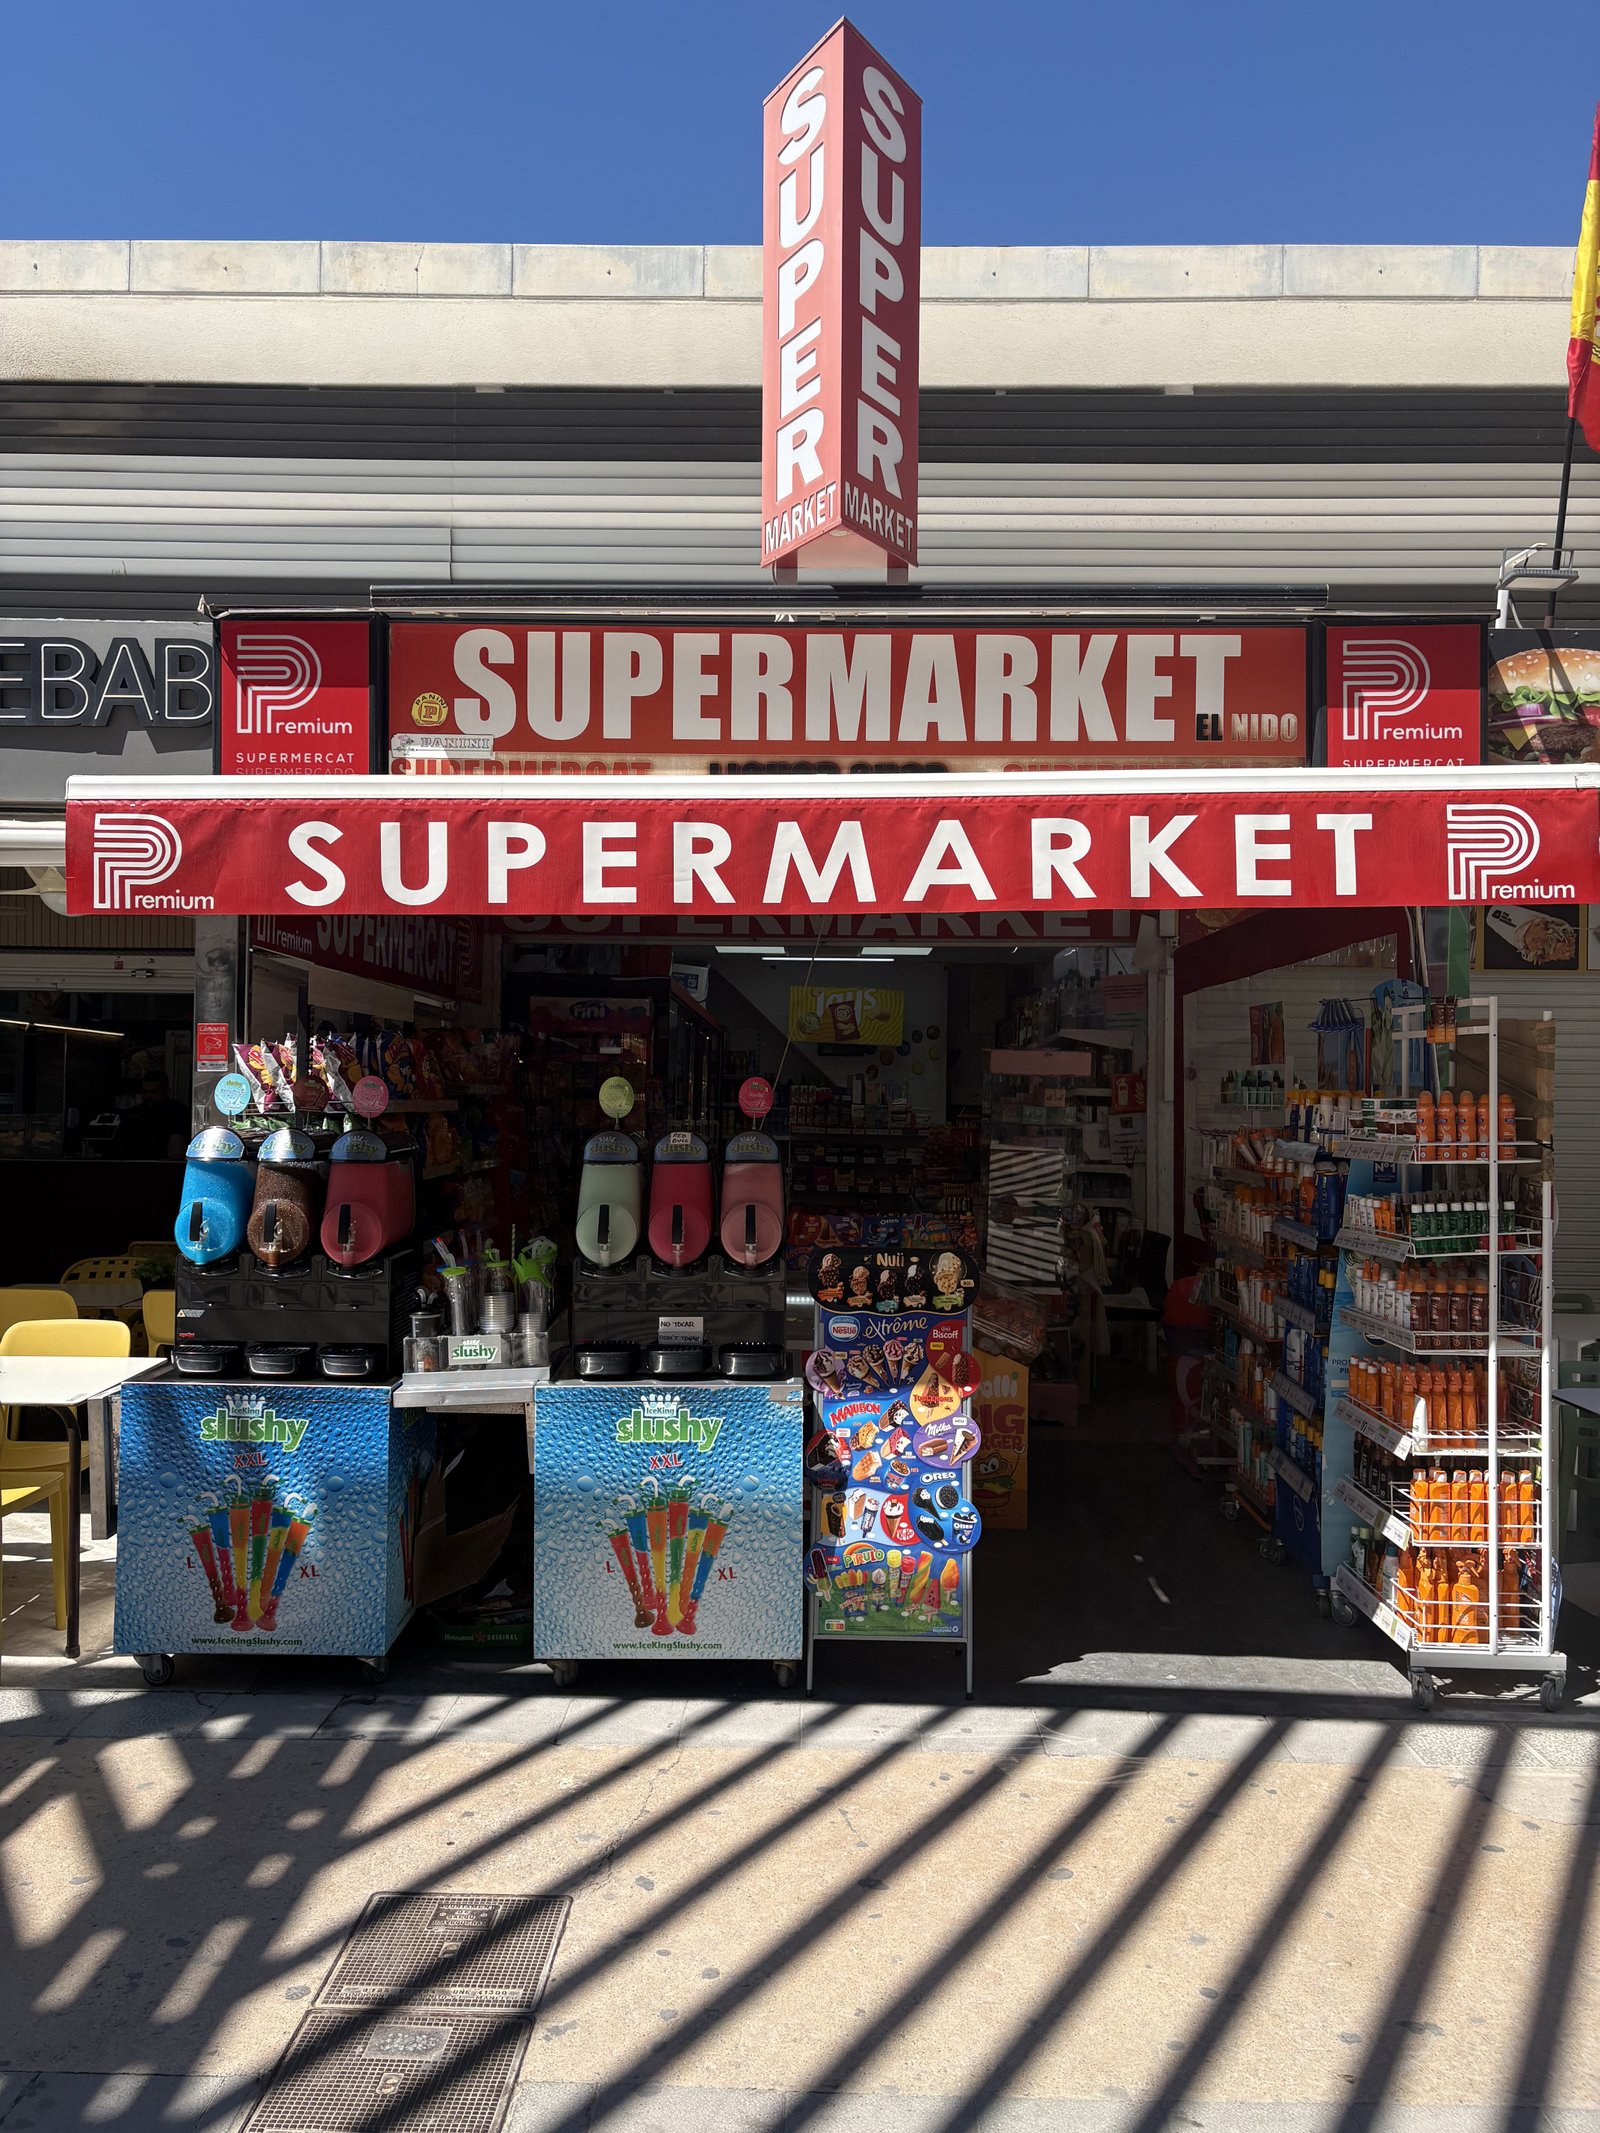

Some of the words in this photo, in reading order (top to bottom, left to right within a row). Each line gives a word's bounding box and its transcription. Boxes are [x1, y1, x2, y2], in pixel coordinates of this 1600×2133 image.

[776, 65, 827, 502] SUPER
[857, 65, 907, 501] SUPER
[764, 483, 837, 556] MARKET
[844, 485, 914, 553] MARKET
[453, 628, 1242, 742] SUPERMARKET
[415, 693, 448, 709] PANINI
[1195, 713, 1223, 742] EL
[1230, 713, 1298, 743] NIDO
[420, 737, 490, 749] PANINI
[235, 752, 355, 764] SUPERMERCAT
[284, 813, 1373, 908] SUPERMARKET
[876, 1252, 905, 1268] Nuii
[932, 1329, 959, 1339] Biscoff
[453, 1343, 497, 1361] slushy
[231, 1406, 260, 1416] IceKing
[646, 1406, 676, 1416] IceKing
[829, 1402, 882, 1427] MAXIBON
[200, 1409, 308, 1452] slushy
[616, 1408, 723, 1453] slushy
[924, 1423, 952, 1437] Milka
[233, 1452, 267, 1469] XXL
[649, 1453, 684, 1470] XXL
[921, 1472, 957, 1484] OREO
[300, 1564, 321, 1579] XL
[717, 1566, 738, 1582] XL
[191, 1635, 303, 1647] www.IceKingSlushy.com
[613, 1641, 723, 1651] www.IceKingSlushy.com
